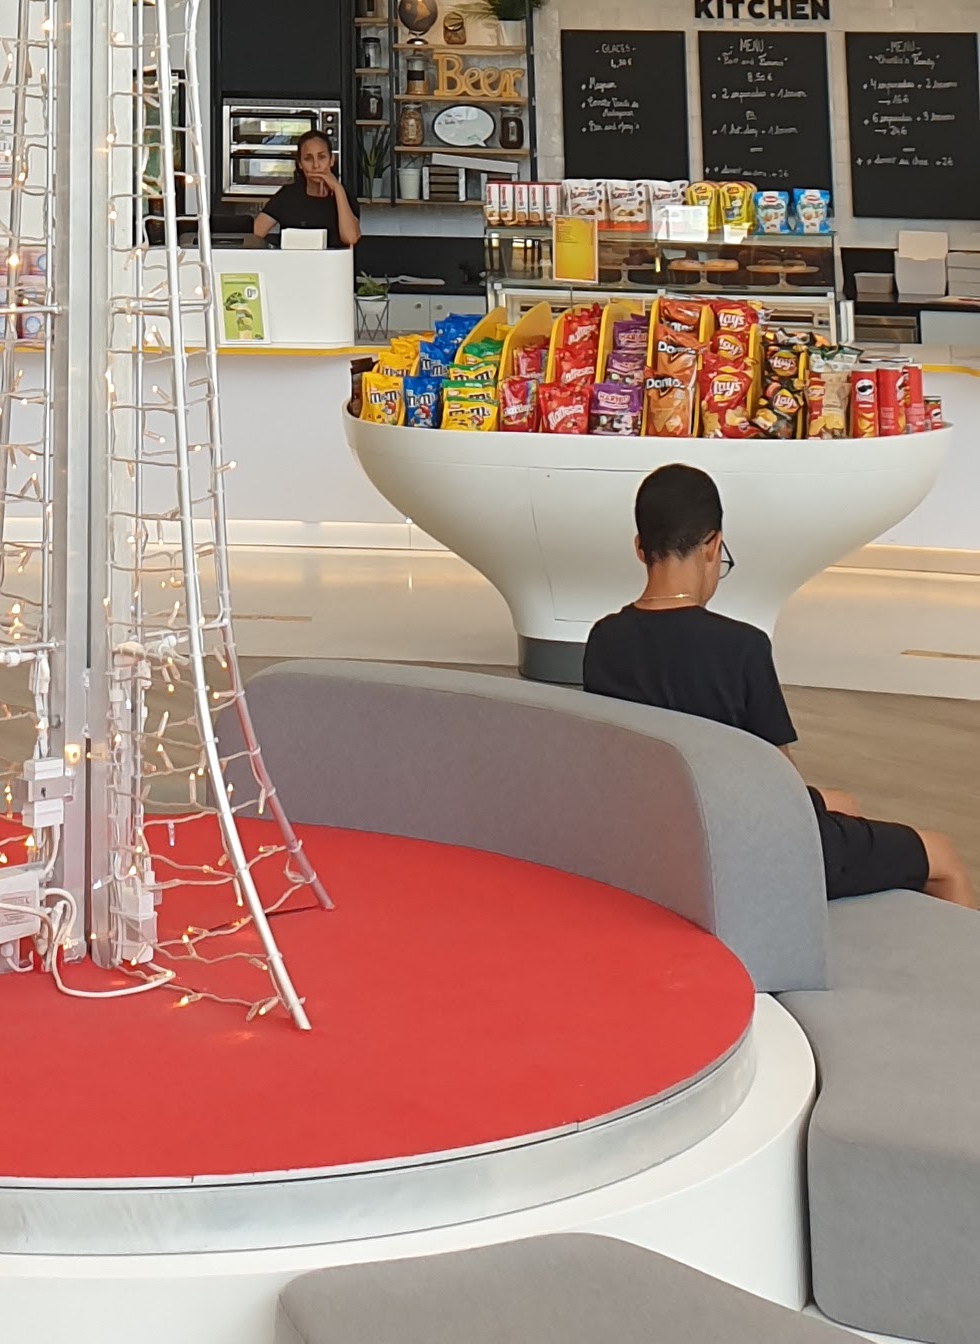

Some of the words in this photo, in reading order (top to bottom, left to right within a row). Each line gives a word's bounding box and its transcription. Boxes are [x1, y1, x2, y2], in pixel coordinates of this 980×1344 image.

[433, 53, 525, 98] Beer
[719, 312, 745, 328] Lay's
[713, 381, 742, 397] Lay's
